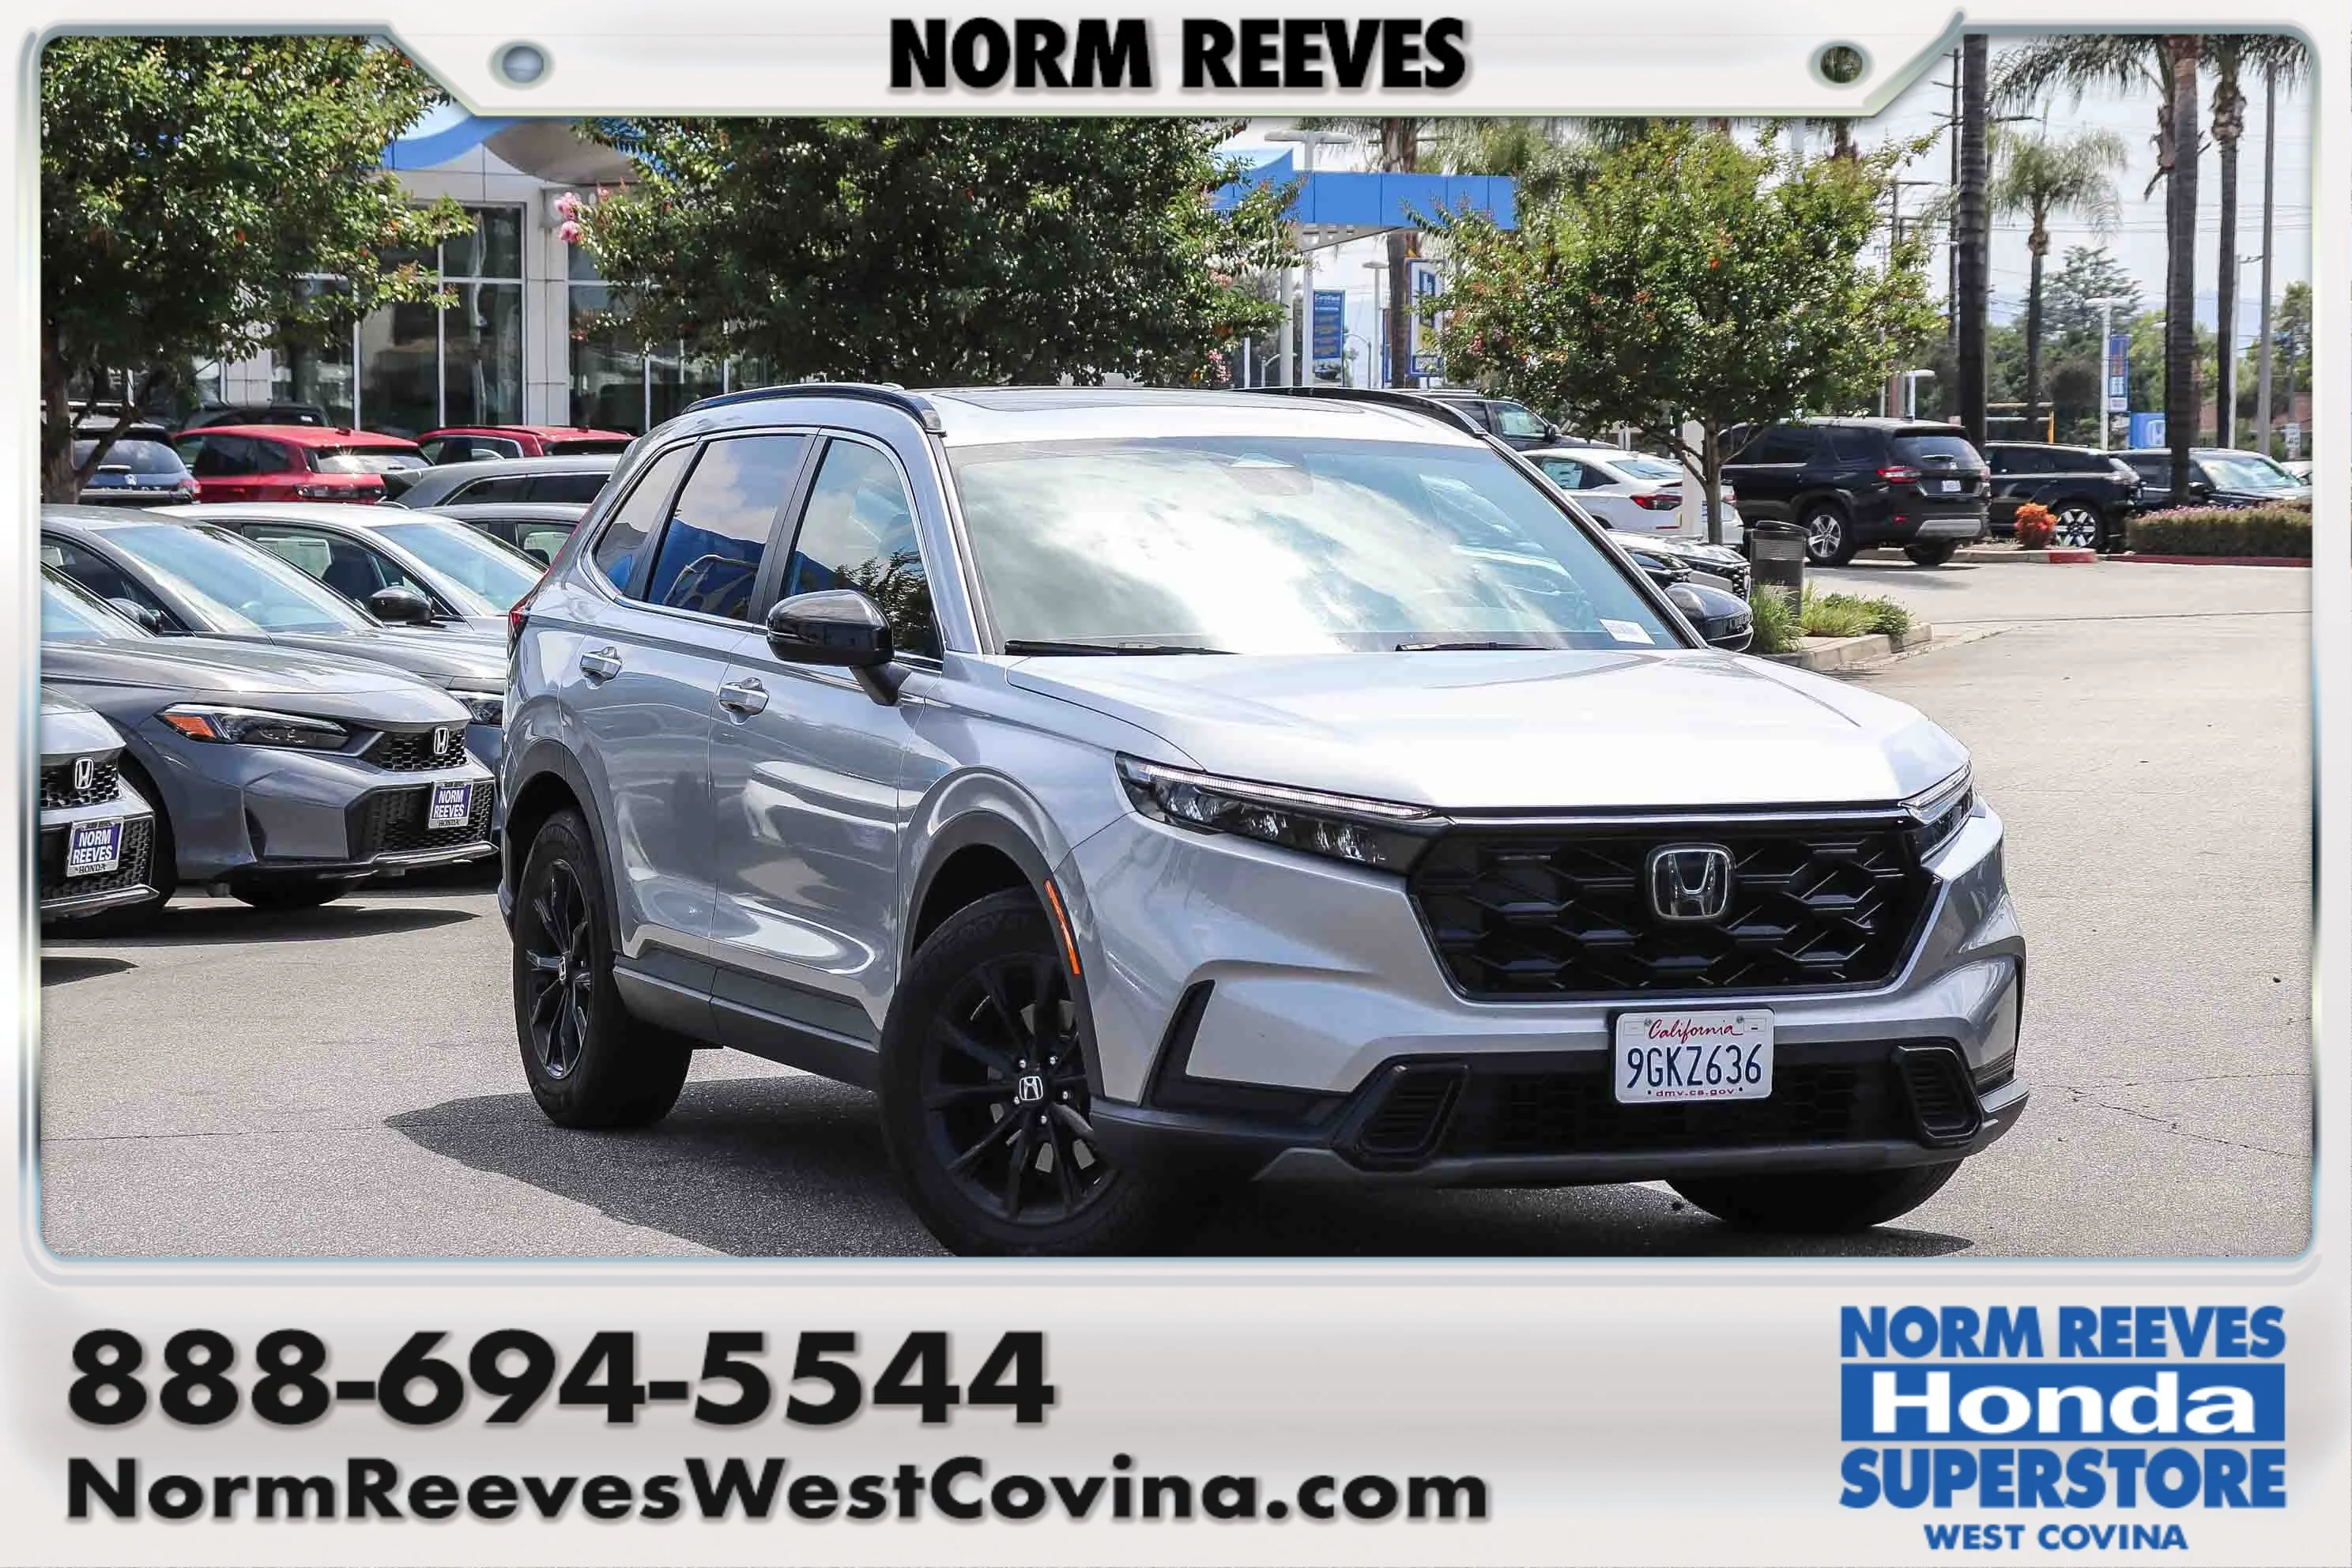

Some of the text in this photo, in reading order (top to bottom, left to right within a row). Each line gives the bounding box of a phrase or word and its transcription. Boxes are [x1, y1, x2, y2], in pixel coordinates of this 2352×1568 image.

[438, 790, 465, 804] NORM
[433, 804, 465, 819] REEVES
[79, 829, 111, 848] NORM
[73, 845, 113, 865] REEVES
[1649, 1019, 1743, 1044] California
[1626, 1043, 1762, 1089] 9GKZ636
[1656, 1087, 1735, 1097] dmv.ca.gov
